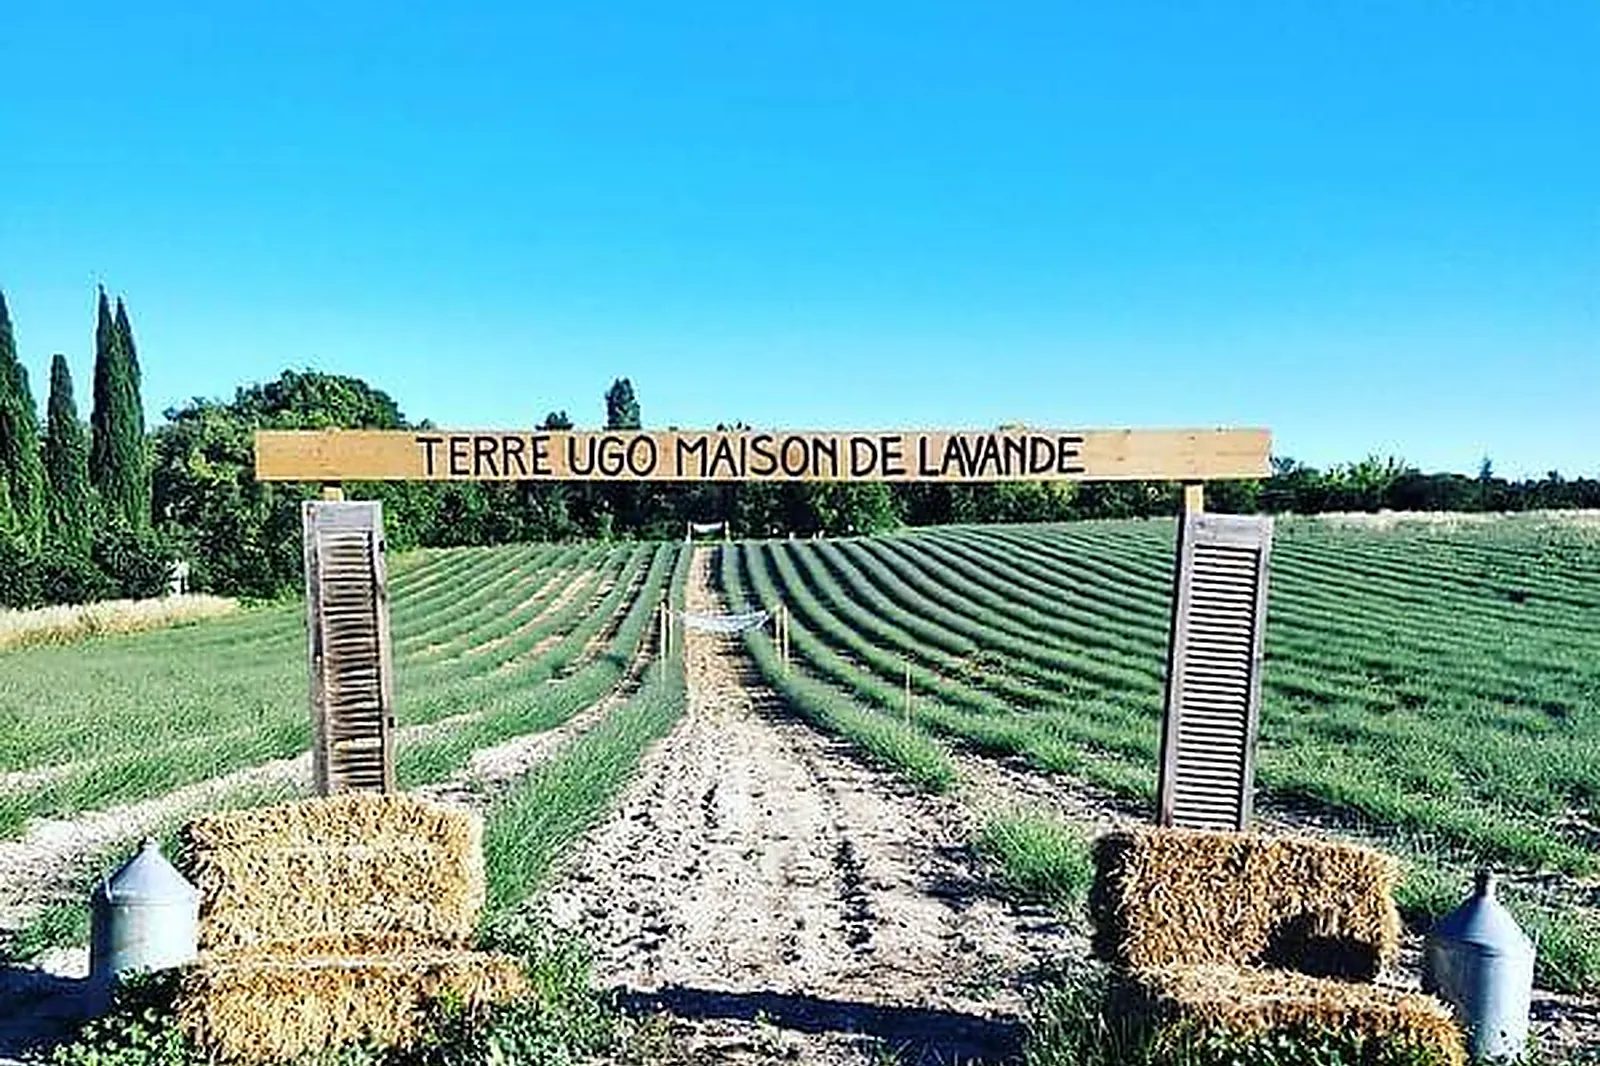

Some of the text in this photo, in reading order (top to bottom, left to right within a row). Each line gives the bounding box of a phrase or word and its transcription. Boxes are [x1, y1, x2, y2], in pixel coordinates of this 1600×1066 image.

[416, 436, 1085, 477] TERRE UGO MAISON DE LAVANDE
